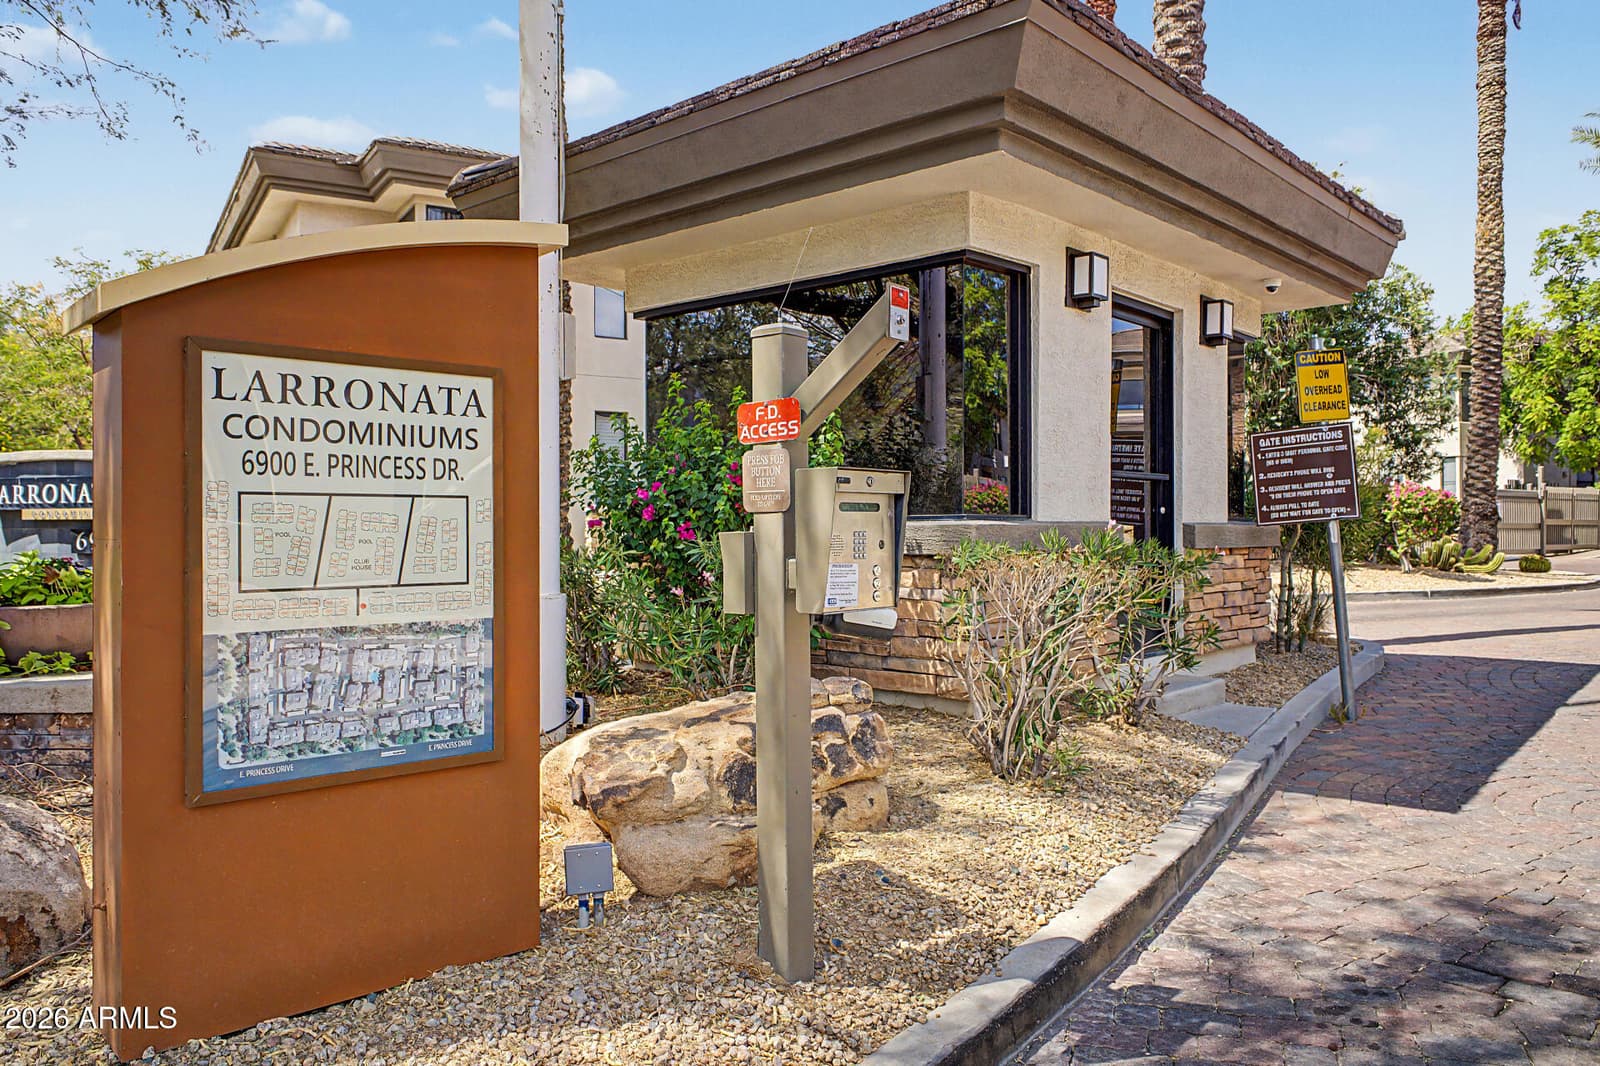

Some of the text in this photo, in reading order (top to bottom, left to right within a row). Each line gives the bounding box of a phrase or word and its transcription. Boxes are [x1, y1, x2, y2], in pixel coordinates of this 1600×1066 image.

[1300, 352, 1341, 364] CAUTION
[1314, 369, 1330, 380] LOW
[211, 366, 487, 418] LARRONATA
[1304, 384, 1343, 396] OVERHEAD
[1304, 400, 1346, 412] CLEARANCE
[755, 405, 781, 421] F.D.
[222, 413, 479, 450] CONDOMINIUMS
[740, 420, 799, 440] ACCESS
[1258, 429, 1342, 447] GATE INSTRUCTIONS
[241, 450, 465, 482] 6900 E. PRINCESS DR.
[747, 454, 769, 465] PRESS
[751, 465, 781, 476] BUTTON
[756, 477, 776, 488] HERE
[0, 482, 93, 504] ARRONA
[457, 739, 472, 747] DRIVE
[246, 766, 275, 778] PRINCESS
[276, 764, 294, 774] DRIVE
